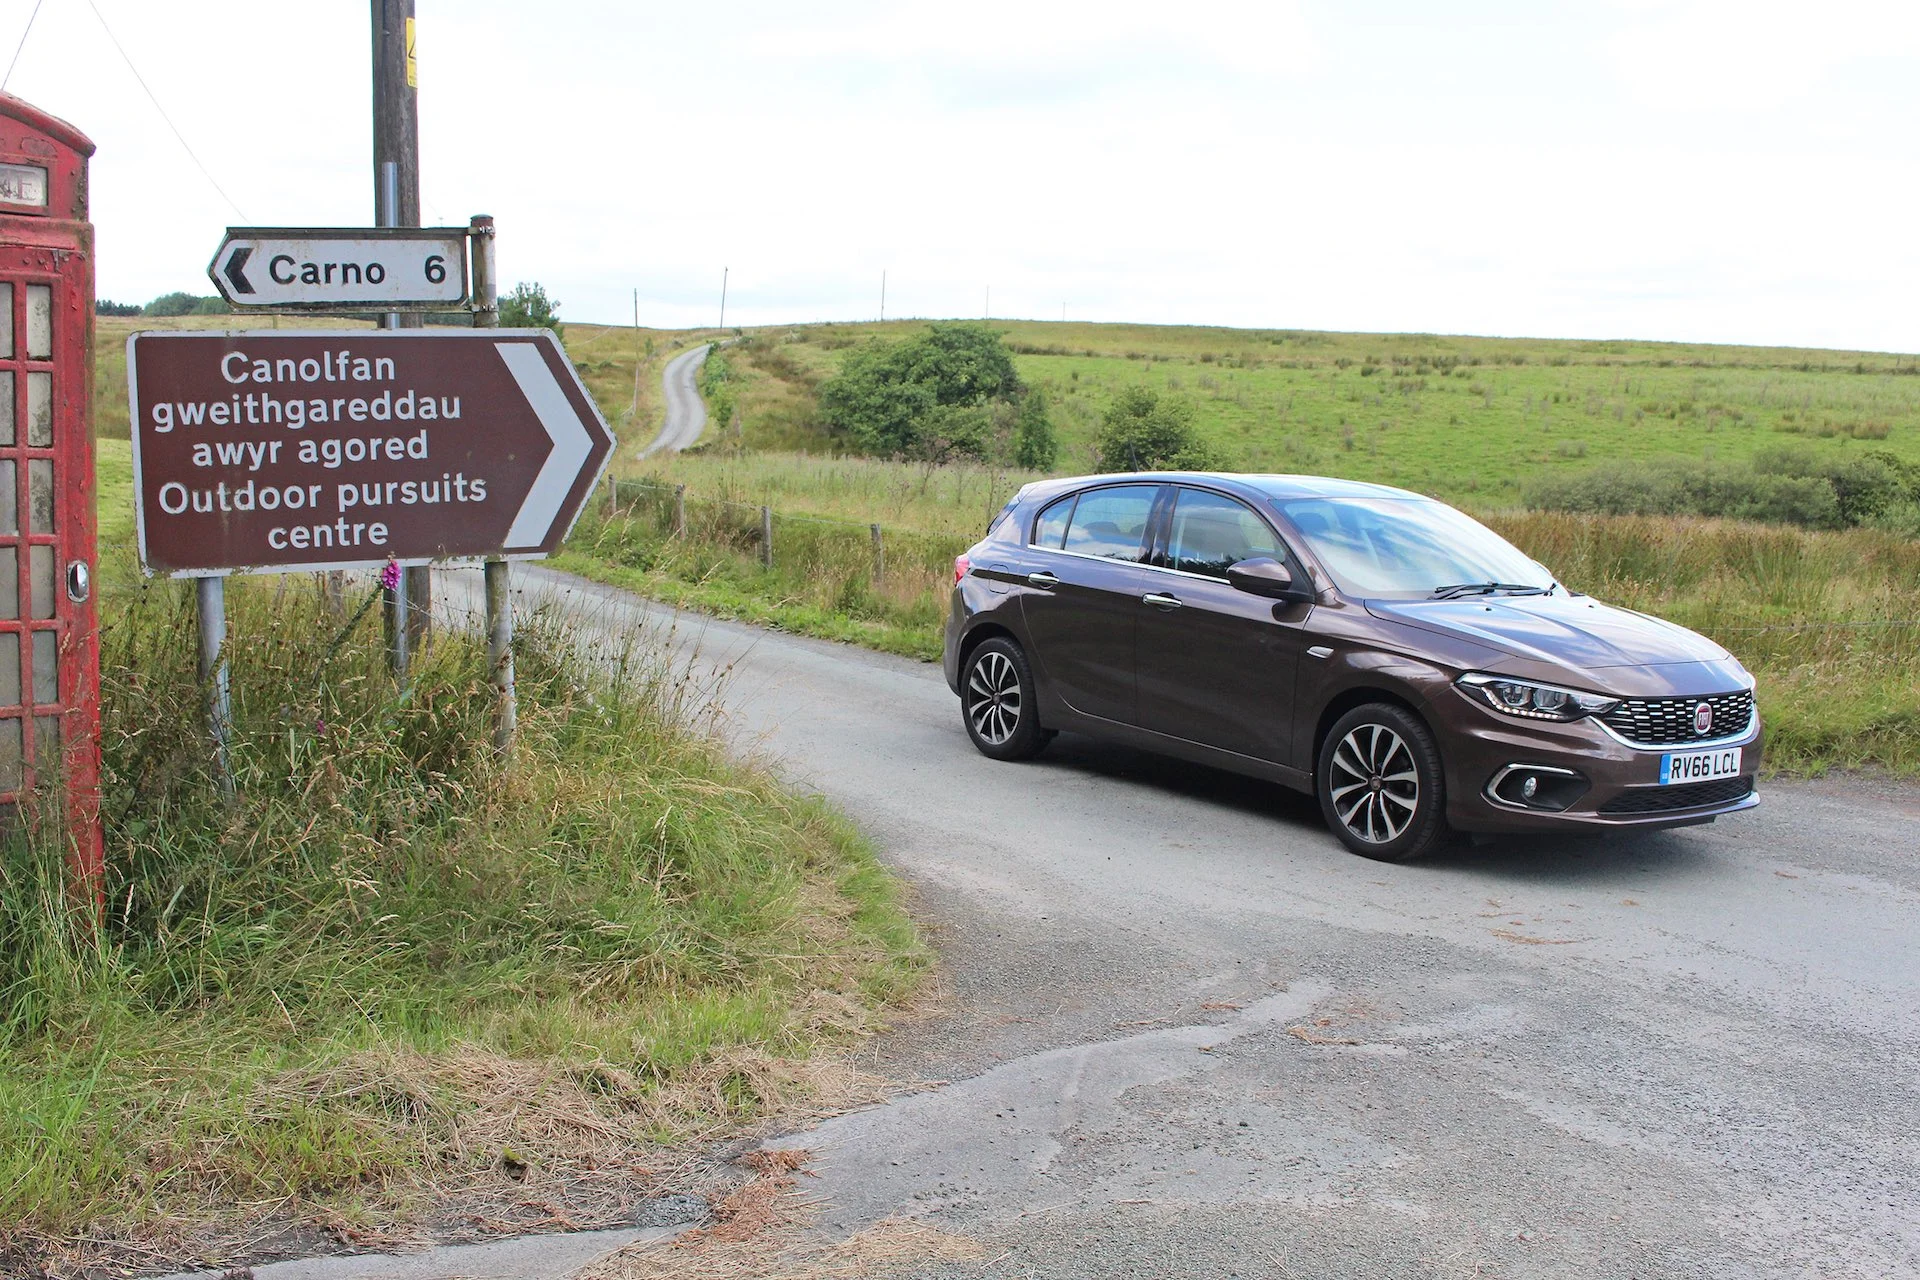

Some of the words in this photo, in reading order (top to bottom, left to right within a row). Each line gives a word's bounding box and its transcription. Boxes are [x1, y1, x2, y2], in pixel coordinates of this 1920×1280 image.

[269, 254, 386, 285] Carno
[424, 255, 446, 284] 6
[220, 351, 396, 384] Canolfan
[151, 390, 461, 433] gweithgareddau
[192, 440, 283, 471] awyr
[298, 429, 429, 468] agored
[158, 480, 322, 514] Outdoor
[337, 472, 487, 512] pursuits
[267, 517, 389, 549] centre
[1671, 756, 1710, 779] RV66
[1713, 752, 1737, 775] LCL
